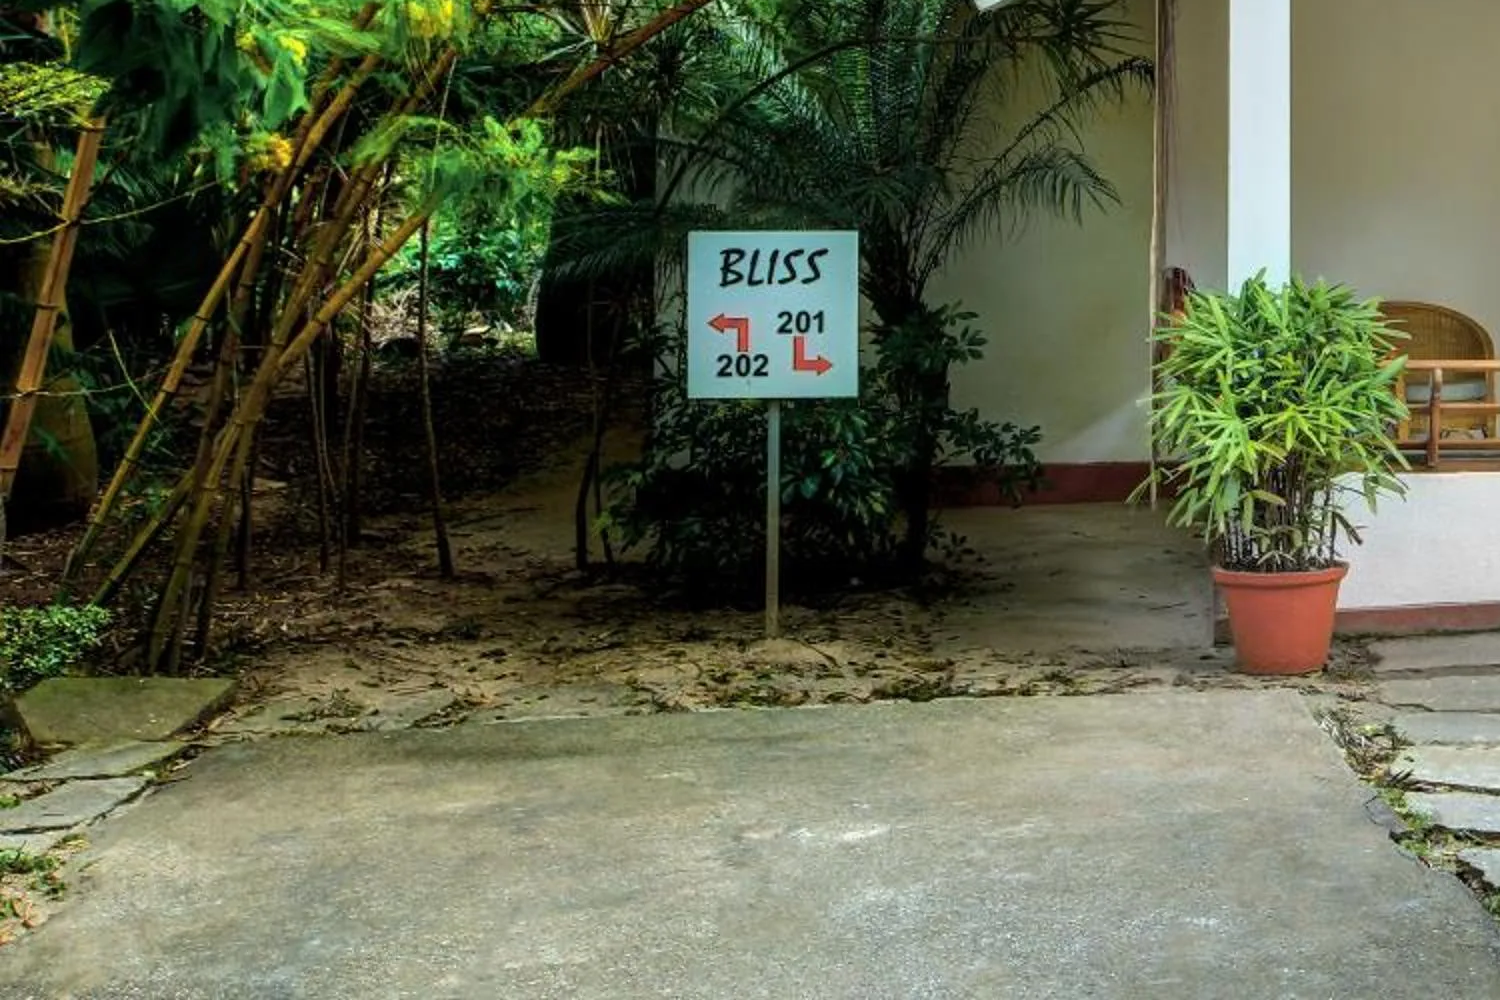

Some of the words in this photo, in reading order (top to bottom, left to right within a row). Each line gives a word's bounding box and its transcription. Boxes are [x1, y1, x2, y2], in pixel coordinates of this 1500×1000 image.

[719, 247, 829, 288] BLISS
[777, 310, 825, 335] 201
[716, 353, 770, 378] 202
